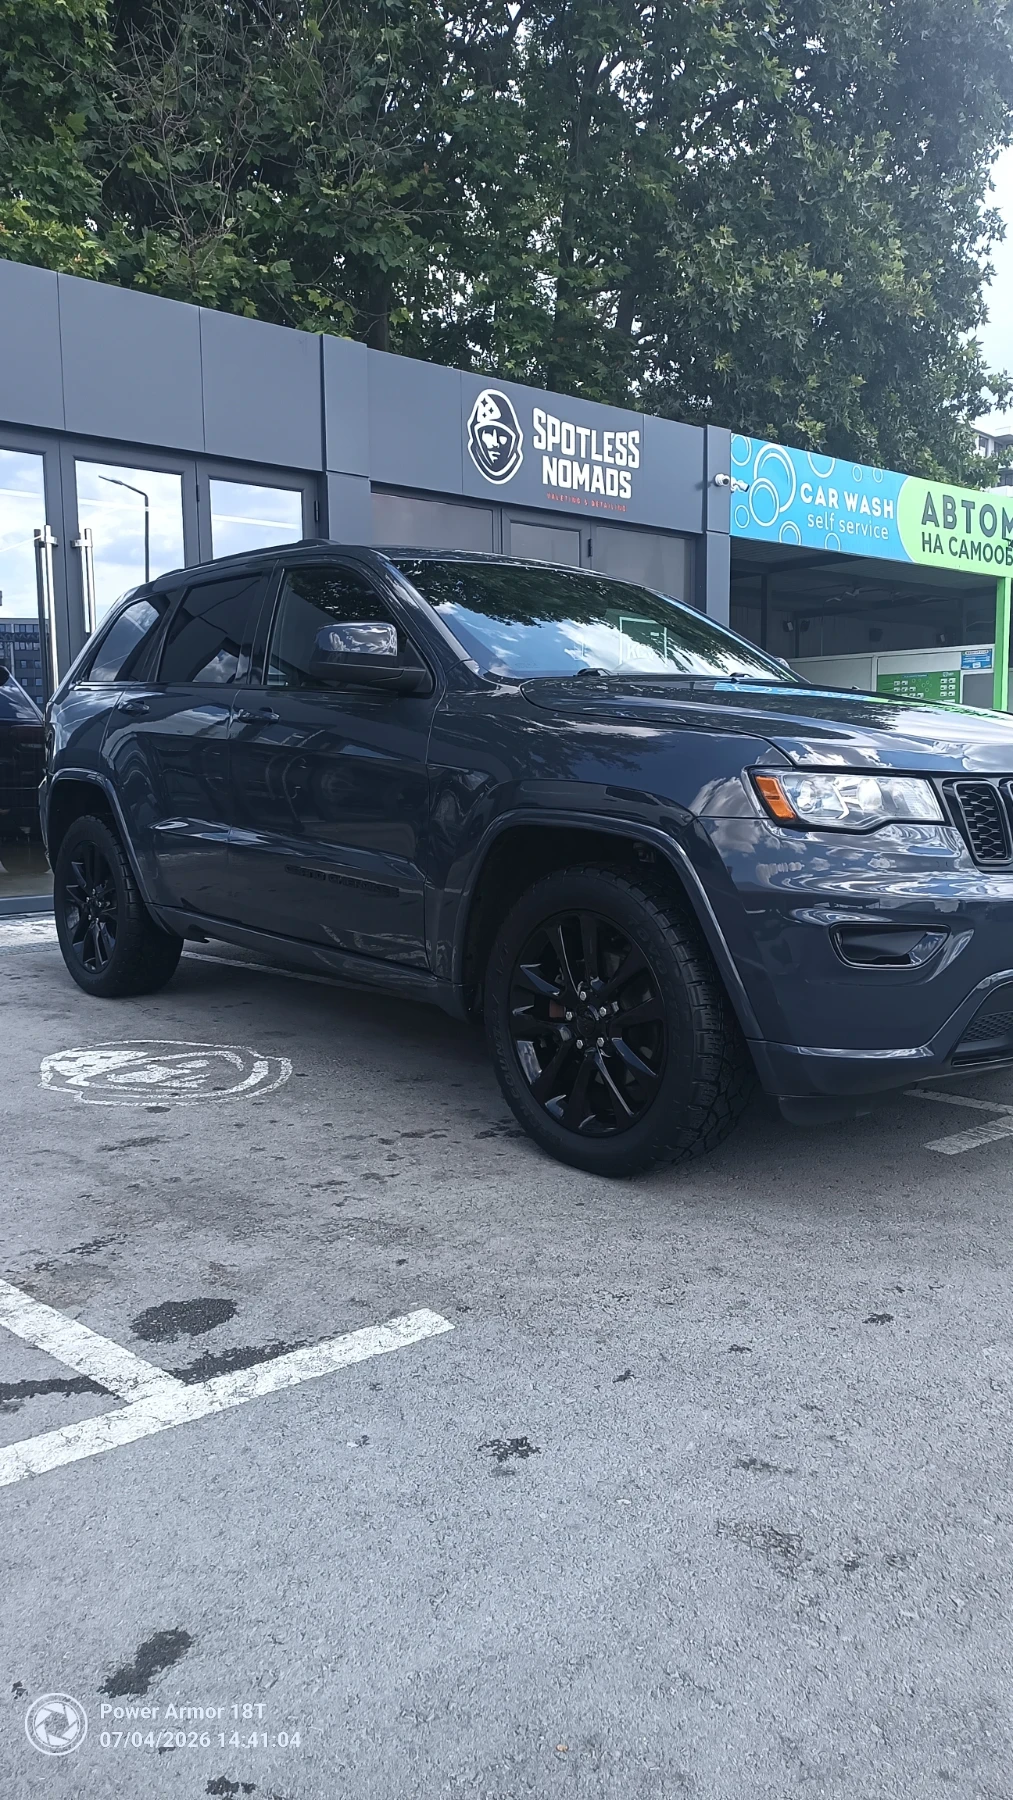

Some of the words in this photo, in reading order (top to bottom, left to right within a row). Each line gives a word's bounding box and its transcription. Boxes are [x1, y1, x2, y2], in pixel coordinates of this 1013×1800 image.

[533, 408, 640, 469] SPOTLESS
[542, 455, 632, 499] NOMADS
[546, 492, 581, 504] VALETING
[591, 499, 627, 512] DETAILING
[800, 483, 839, 510] CAR
[844, 491, 895, 519] WASH
[808, 512, 834, 531] self
[839, 521, 889, 540] service
[921, 532, 944, 555] НА
[949, 535, 1013, 566] САМООБ
